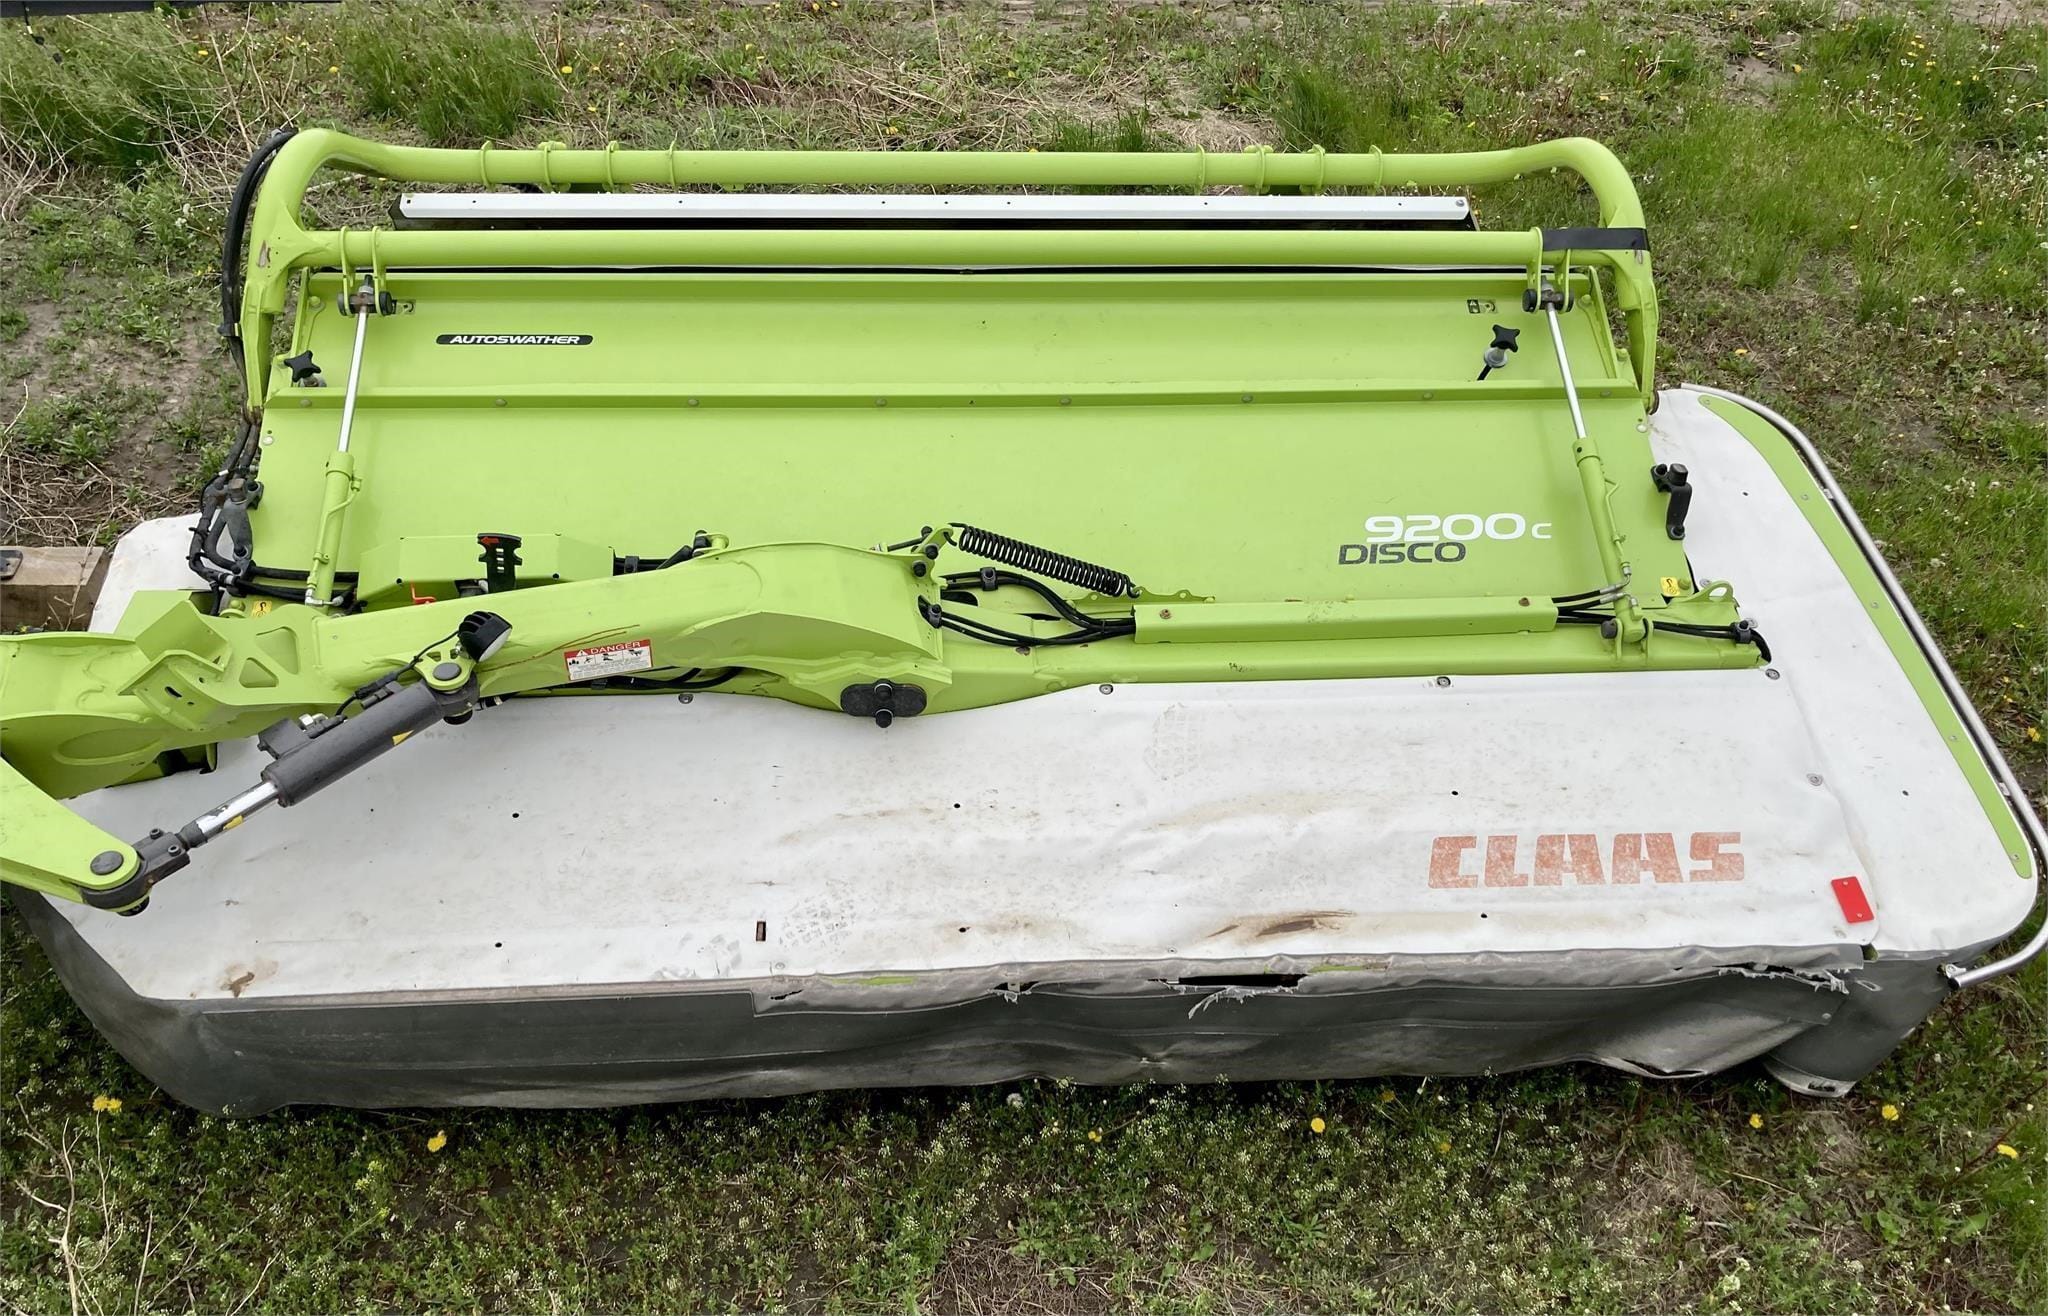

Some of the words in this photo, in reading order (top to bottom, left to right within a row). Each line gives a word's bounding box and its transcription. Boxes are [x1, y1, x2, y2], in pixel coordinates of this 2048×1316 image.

[450, 335, 580, 345] AUTOSWATHER
[1364, 513, 1526, 543] 9200
[1338, 541, 1467, 565] DISCO
[590, 641, 641, 655] DANGER
[1428, 832, 1745, 889] CLAAS
